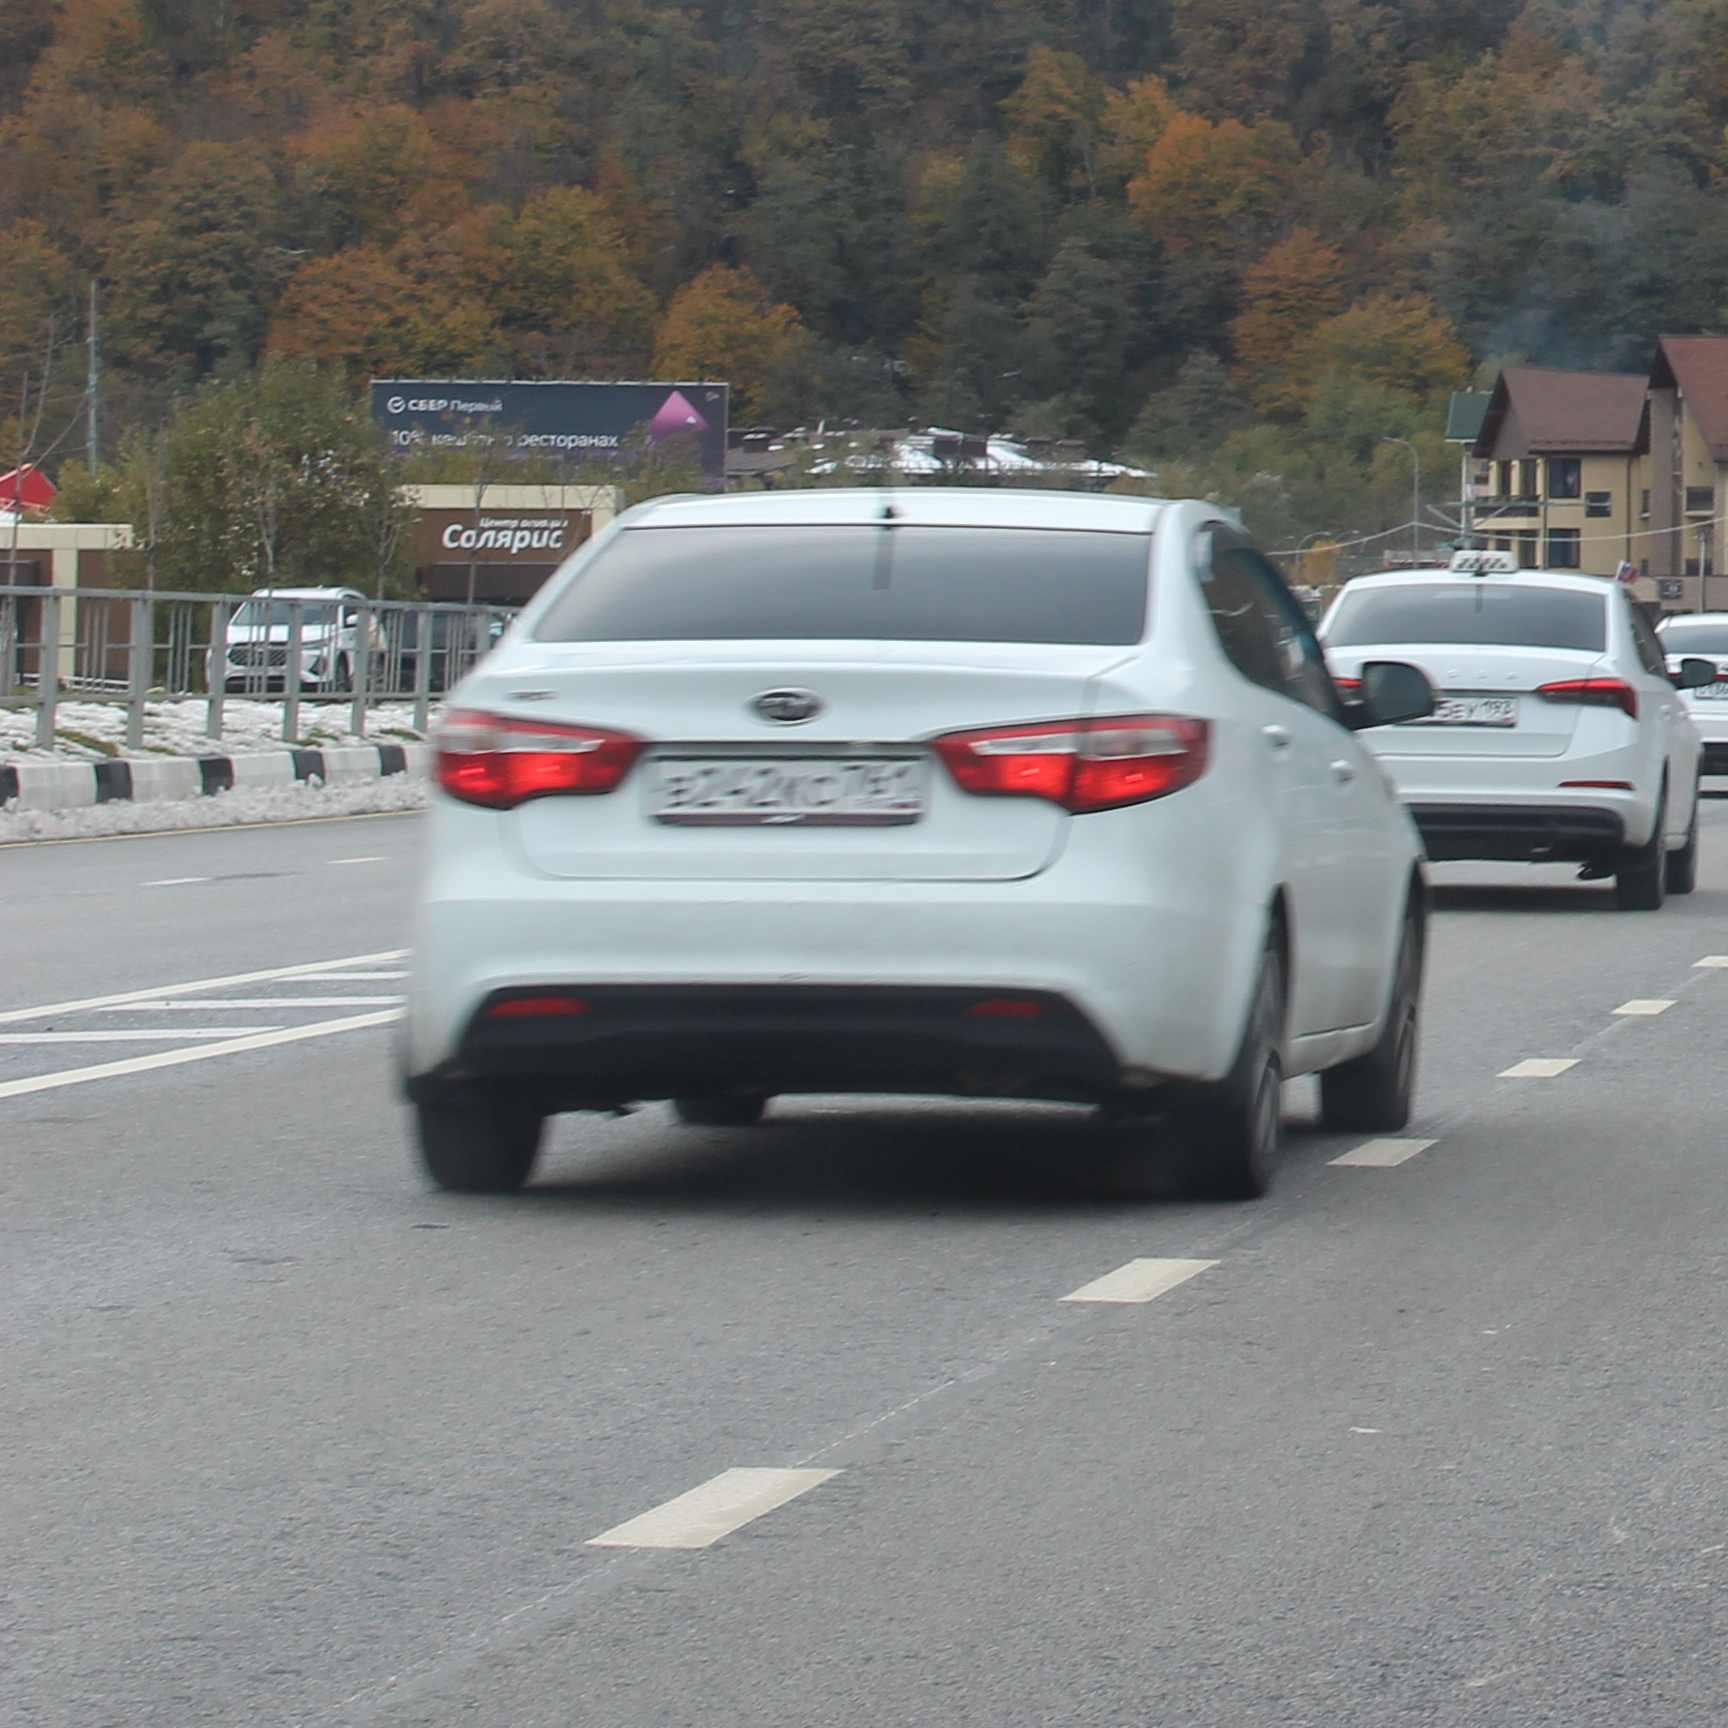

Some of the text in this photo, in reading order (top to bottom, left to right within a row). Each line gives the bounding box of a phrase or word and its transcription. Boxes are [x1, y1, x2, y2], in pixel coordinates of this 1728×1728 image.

[407, 398, 503, 414] СБЕР Первый
[442, 524, 564, 554] Солярис
